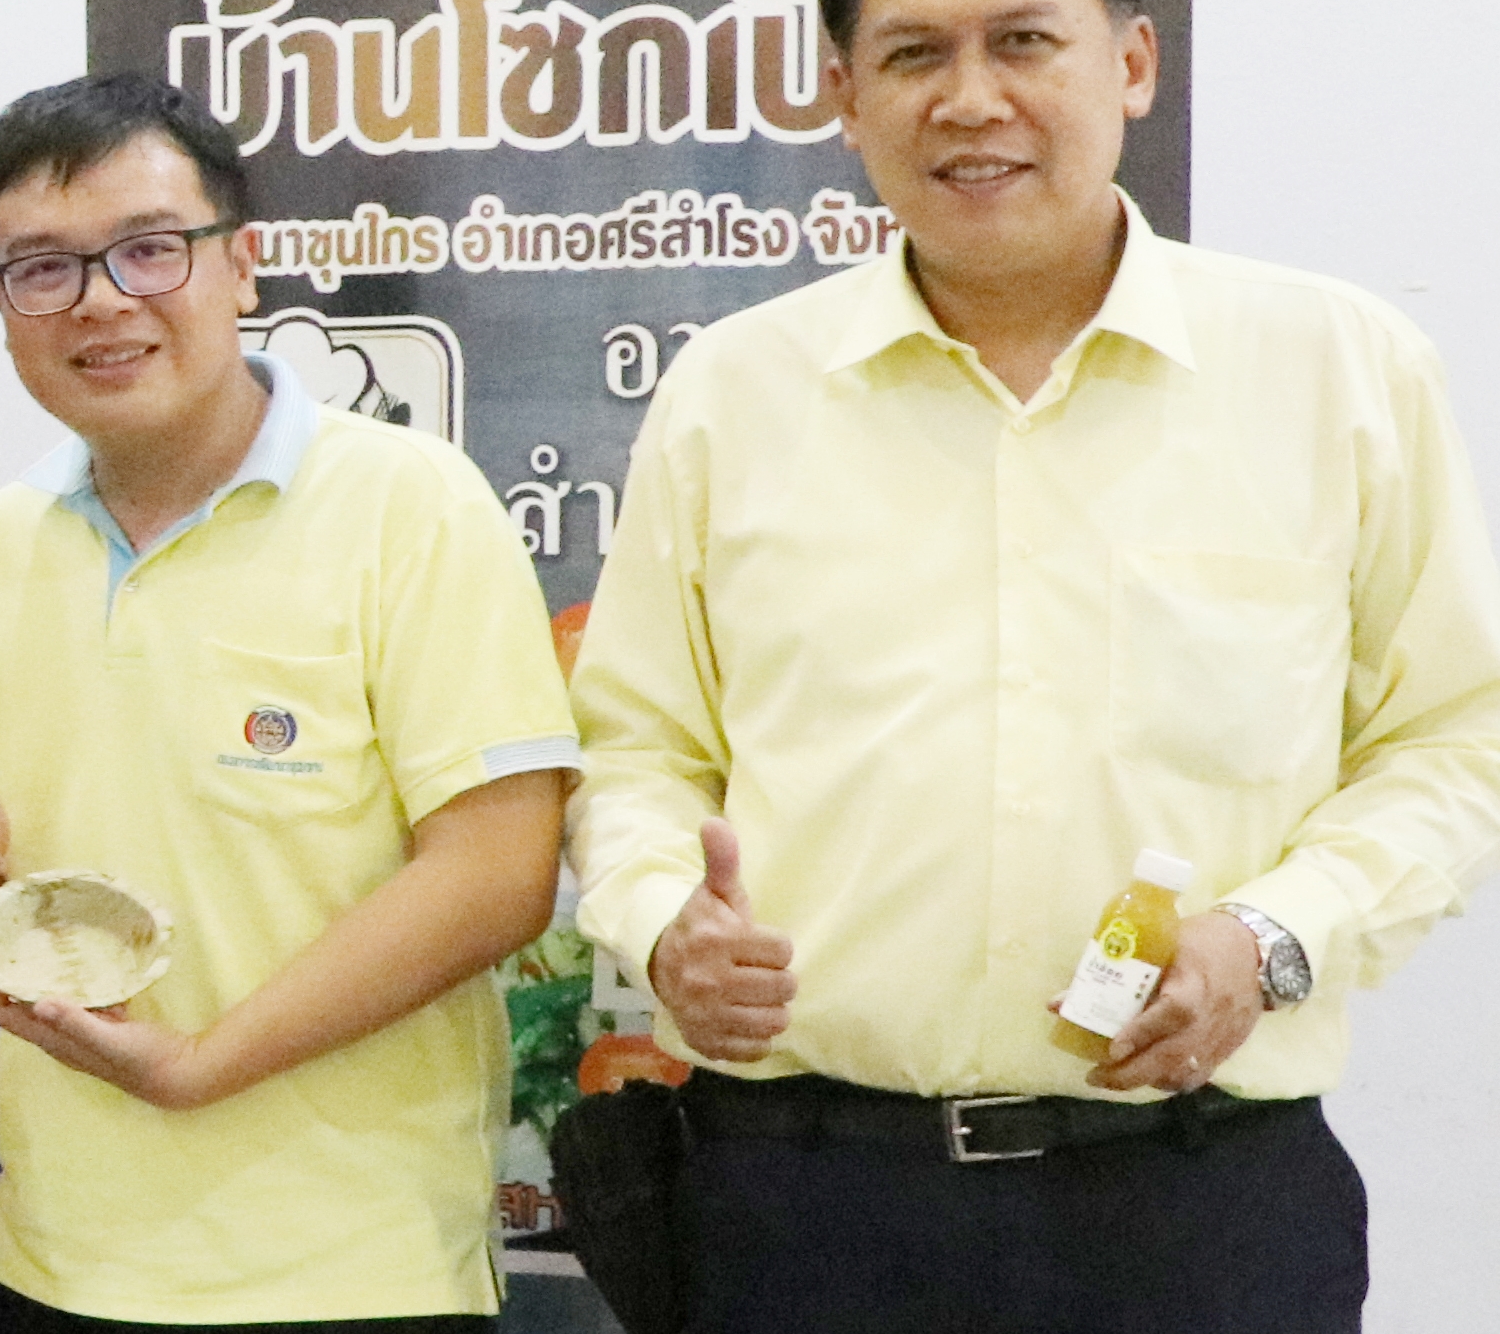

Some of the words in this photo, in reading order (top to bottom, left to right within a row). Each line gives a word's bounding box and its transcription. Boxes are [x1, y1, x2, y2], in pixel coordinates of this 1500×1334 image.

[453, 188, 799, 272] อำเภอศรีสำโรง
[602, 321, 704, 400] อ
